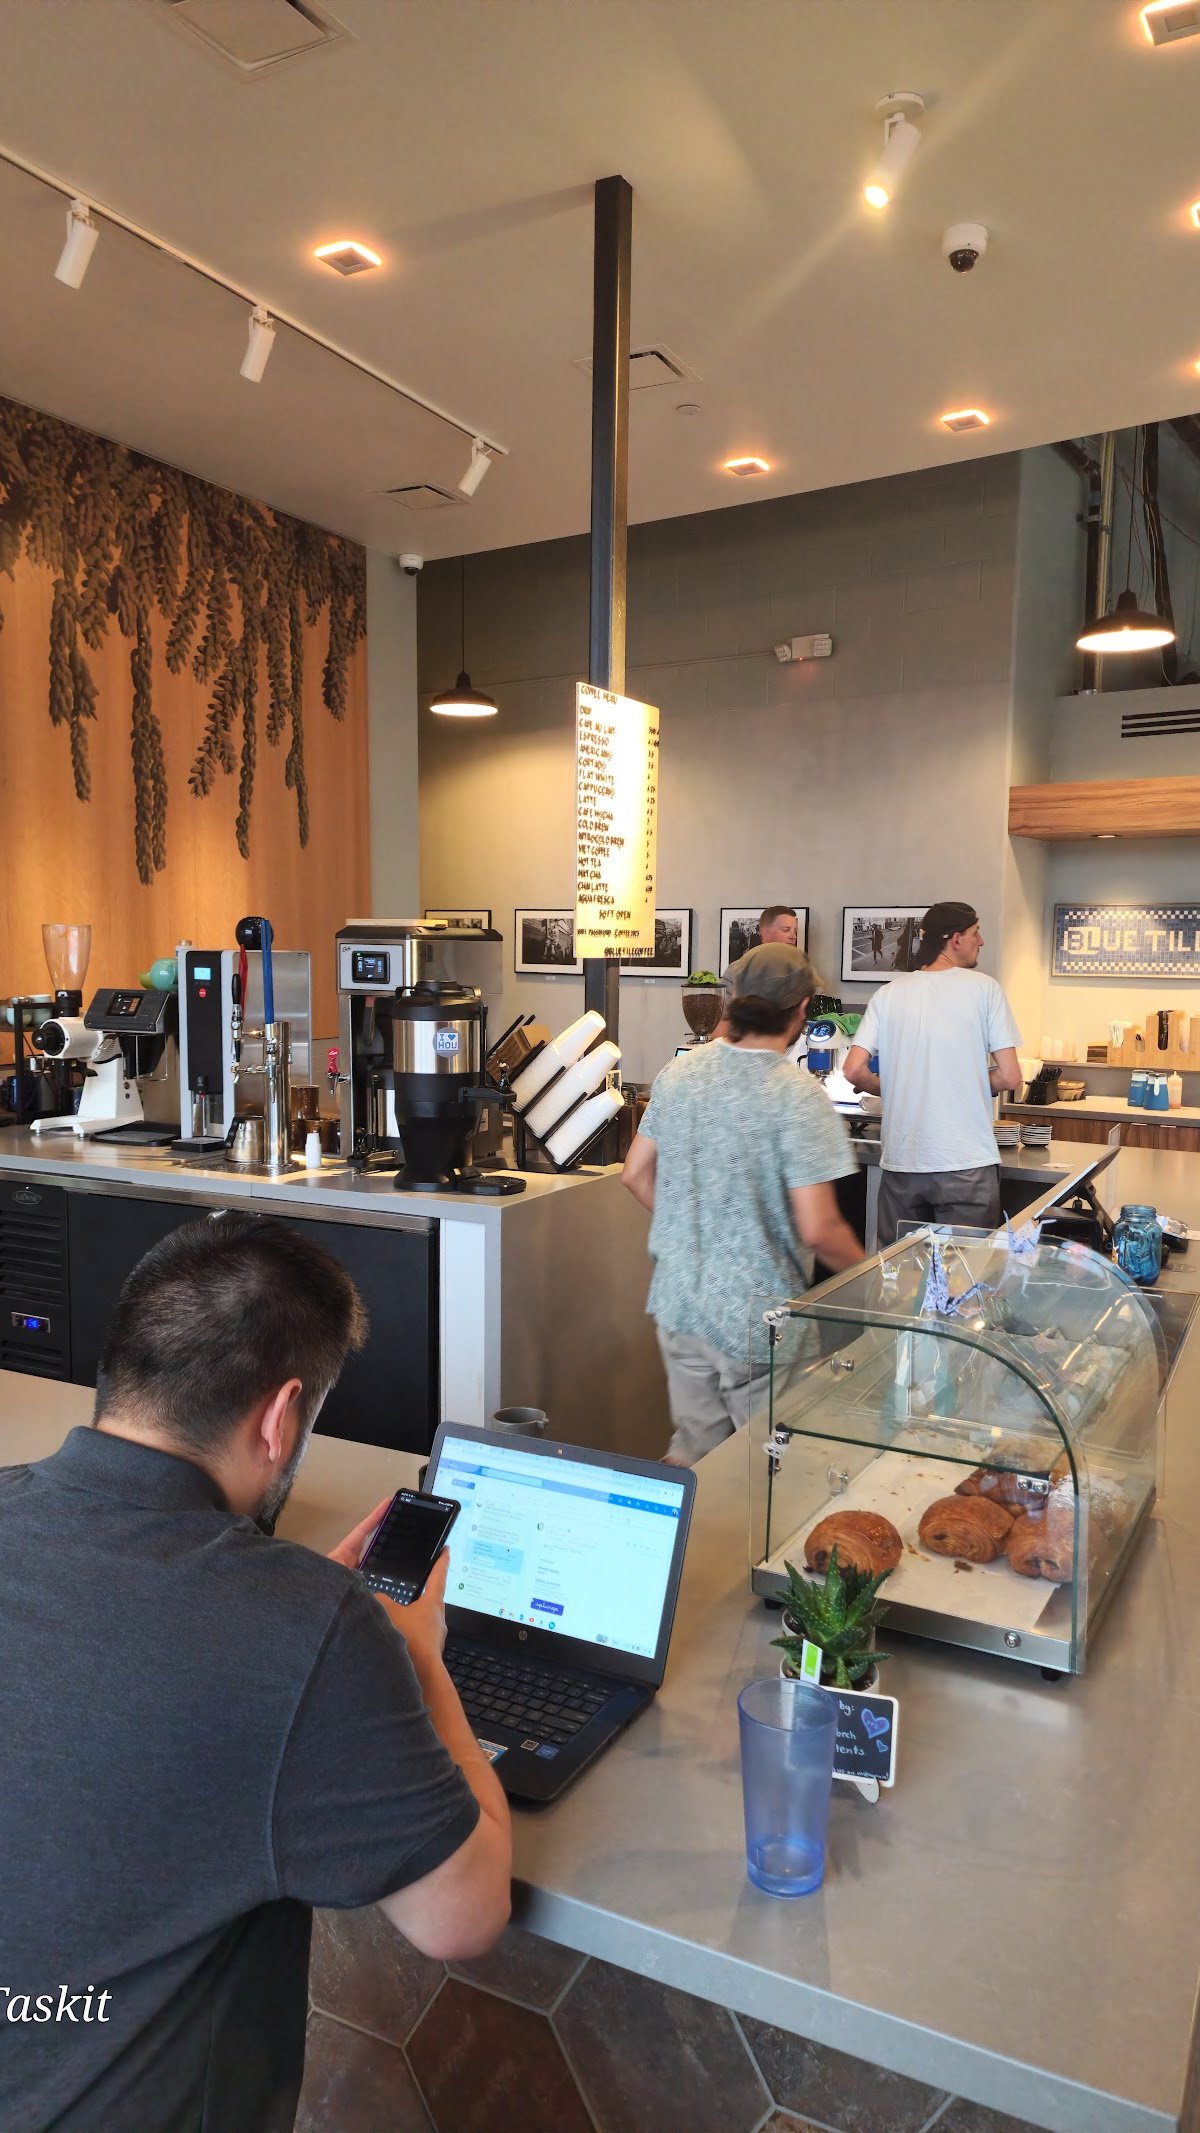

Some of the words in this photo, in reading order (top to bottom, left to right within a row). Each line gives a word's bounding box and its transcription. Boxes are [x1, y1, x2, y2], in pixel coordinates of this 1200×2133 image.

[579, 731, 609, 746] ESPRESSO
[579, 769, 593, 779] FLAT
[596, 773, 614, 785] WHITE
[579, 795, 597, 806] LATTE
[578, 820, 594, 831] COLD
[578, 857, 589, 867] HOT
[590, 858, 602, 868] TEA
[591, 883, 608, 893] LATTE
[578, 894, 592, 904] AGUA
[593, 895, 615, 905] FRESCA
[599, 909, 615, 920] SOFT
[616, 910, 631, 920] OPEN
[1063, 926, 1137, 955] BLUE
[439, 1033, 445, 1042] I
[438, 1041, 458, 1050] HOU
[839, 1700, 855, 1716] by:
